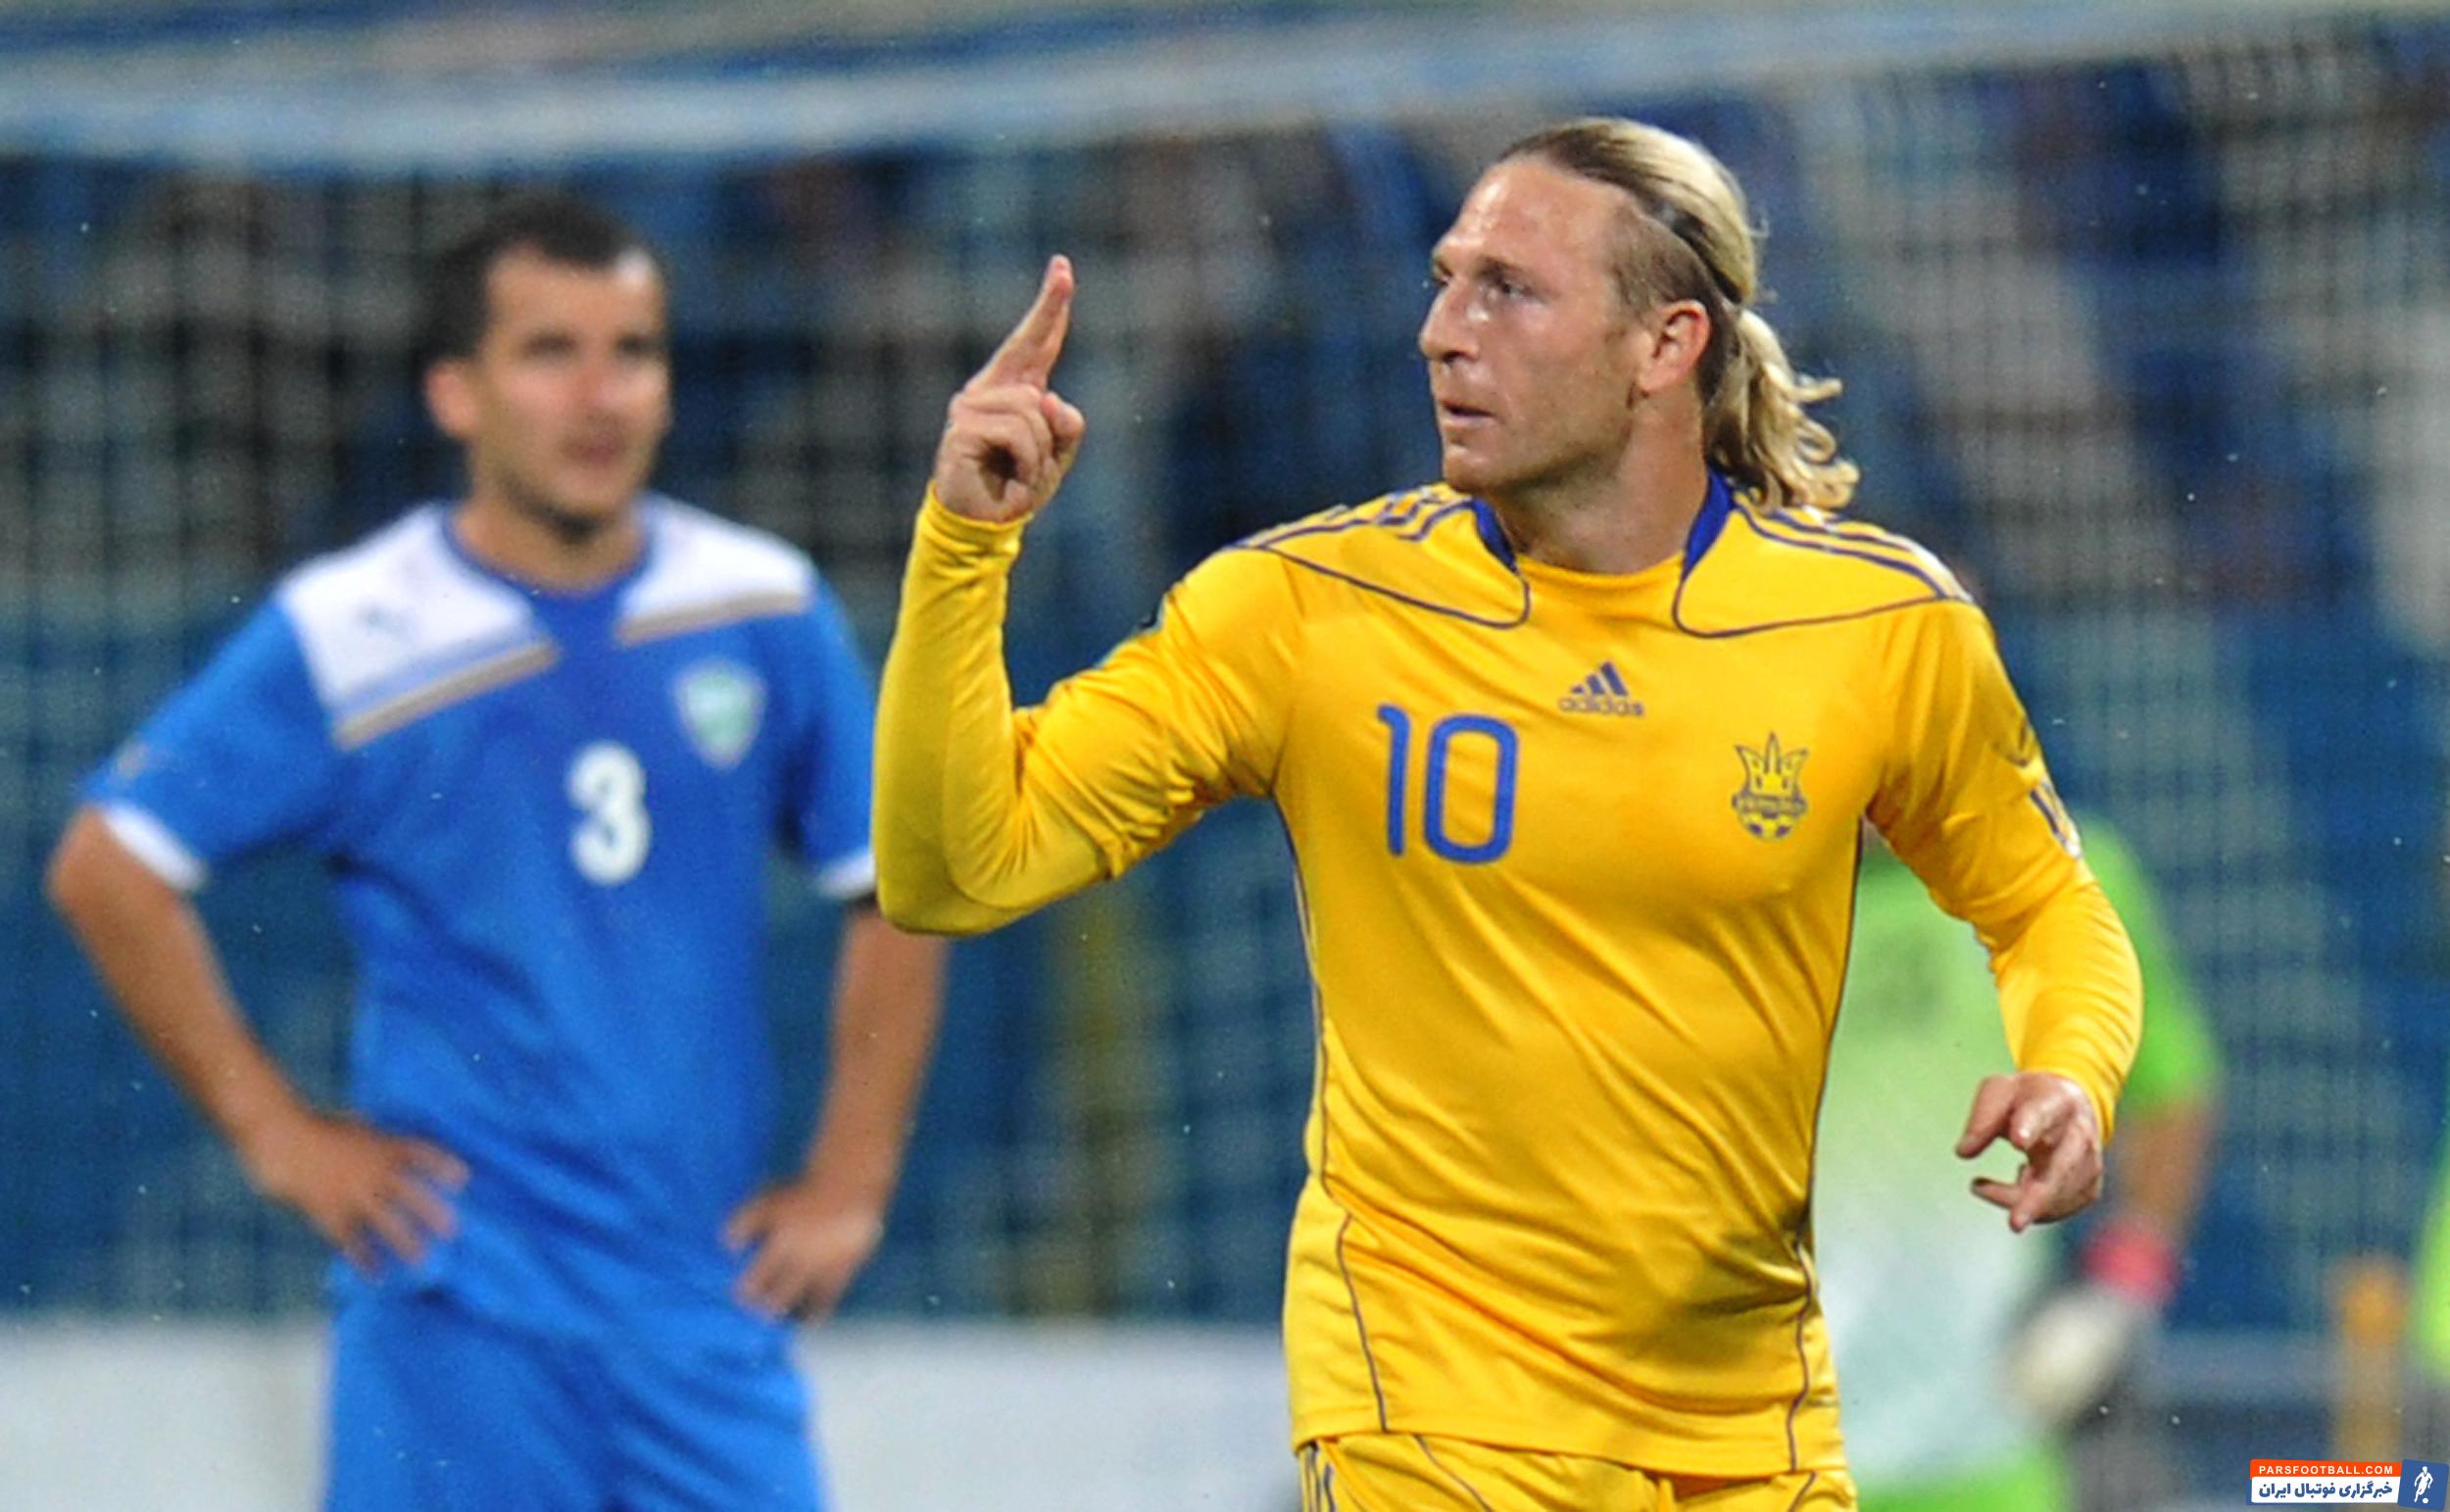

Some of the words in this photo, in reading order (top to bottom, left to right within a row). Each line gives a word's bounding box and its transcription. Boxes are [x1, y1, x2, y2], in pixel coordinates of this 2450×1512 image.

[1558, 695, 1643, 716] adidas
[567, 742, 651, 885] 3
[1377, 704, 1518, 864] 10
